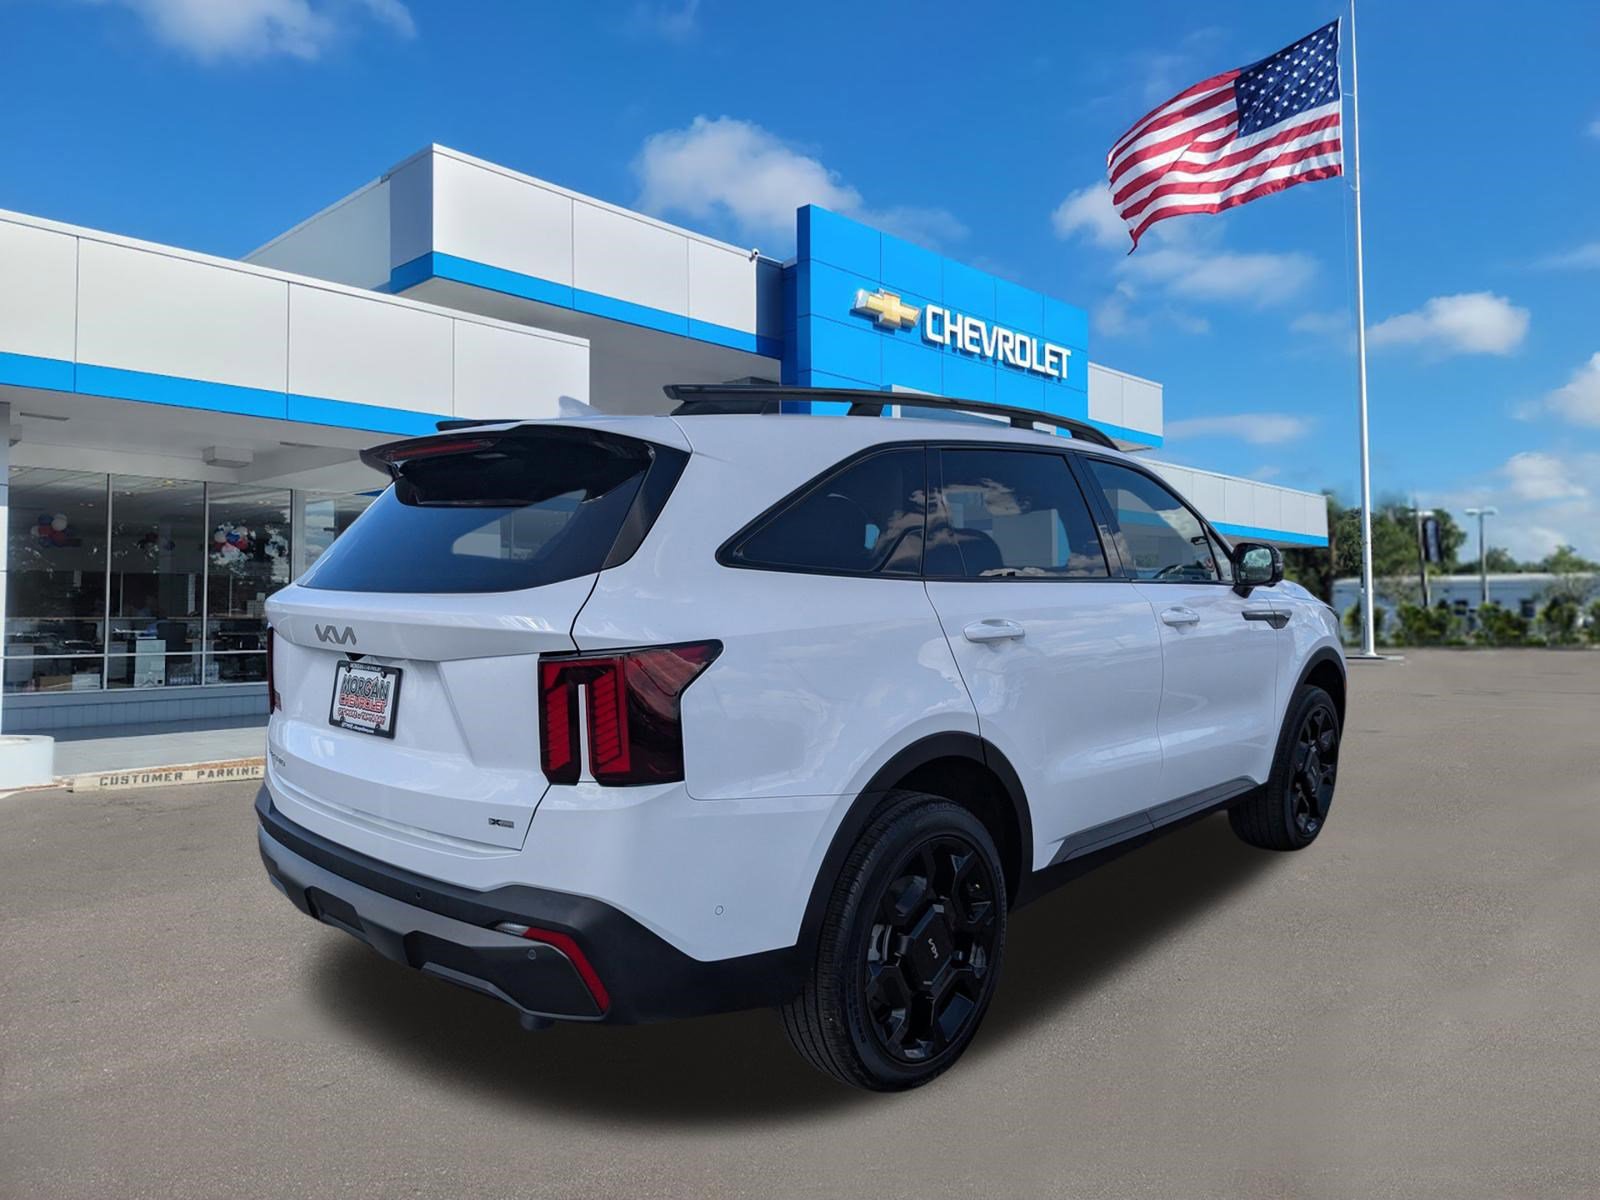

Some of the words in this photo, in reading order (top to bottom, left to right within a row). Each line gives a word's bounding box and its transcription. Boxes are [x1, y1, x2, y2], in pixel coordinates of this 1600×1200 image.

[925, 303, 1072, 379] CHEVROLET
[315, 624, 357, 645] KIA
[341, 673, 391, 700] MORGAN
[339, 694, 386, 714] CHEVROLET
[100, 772, 183, 786] CUSTOMER
[197, 766, 260, 779] PARKING
